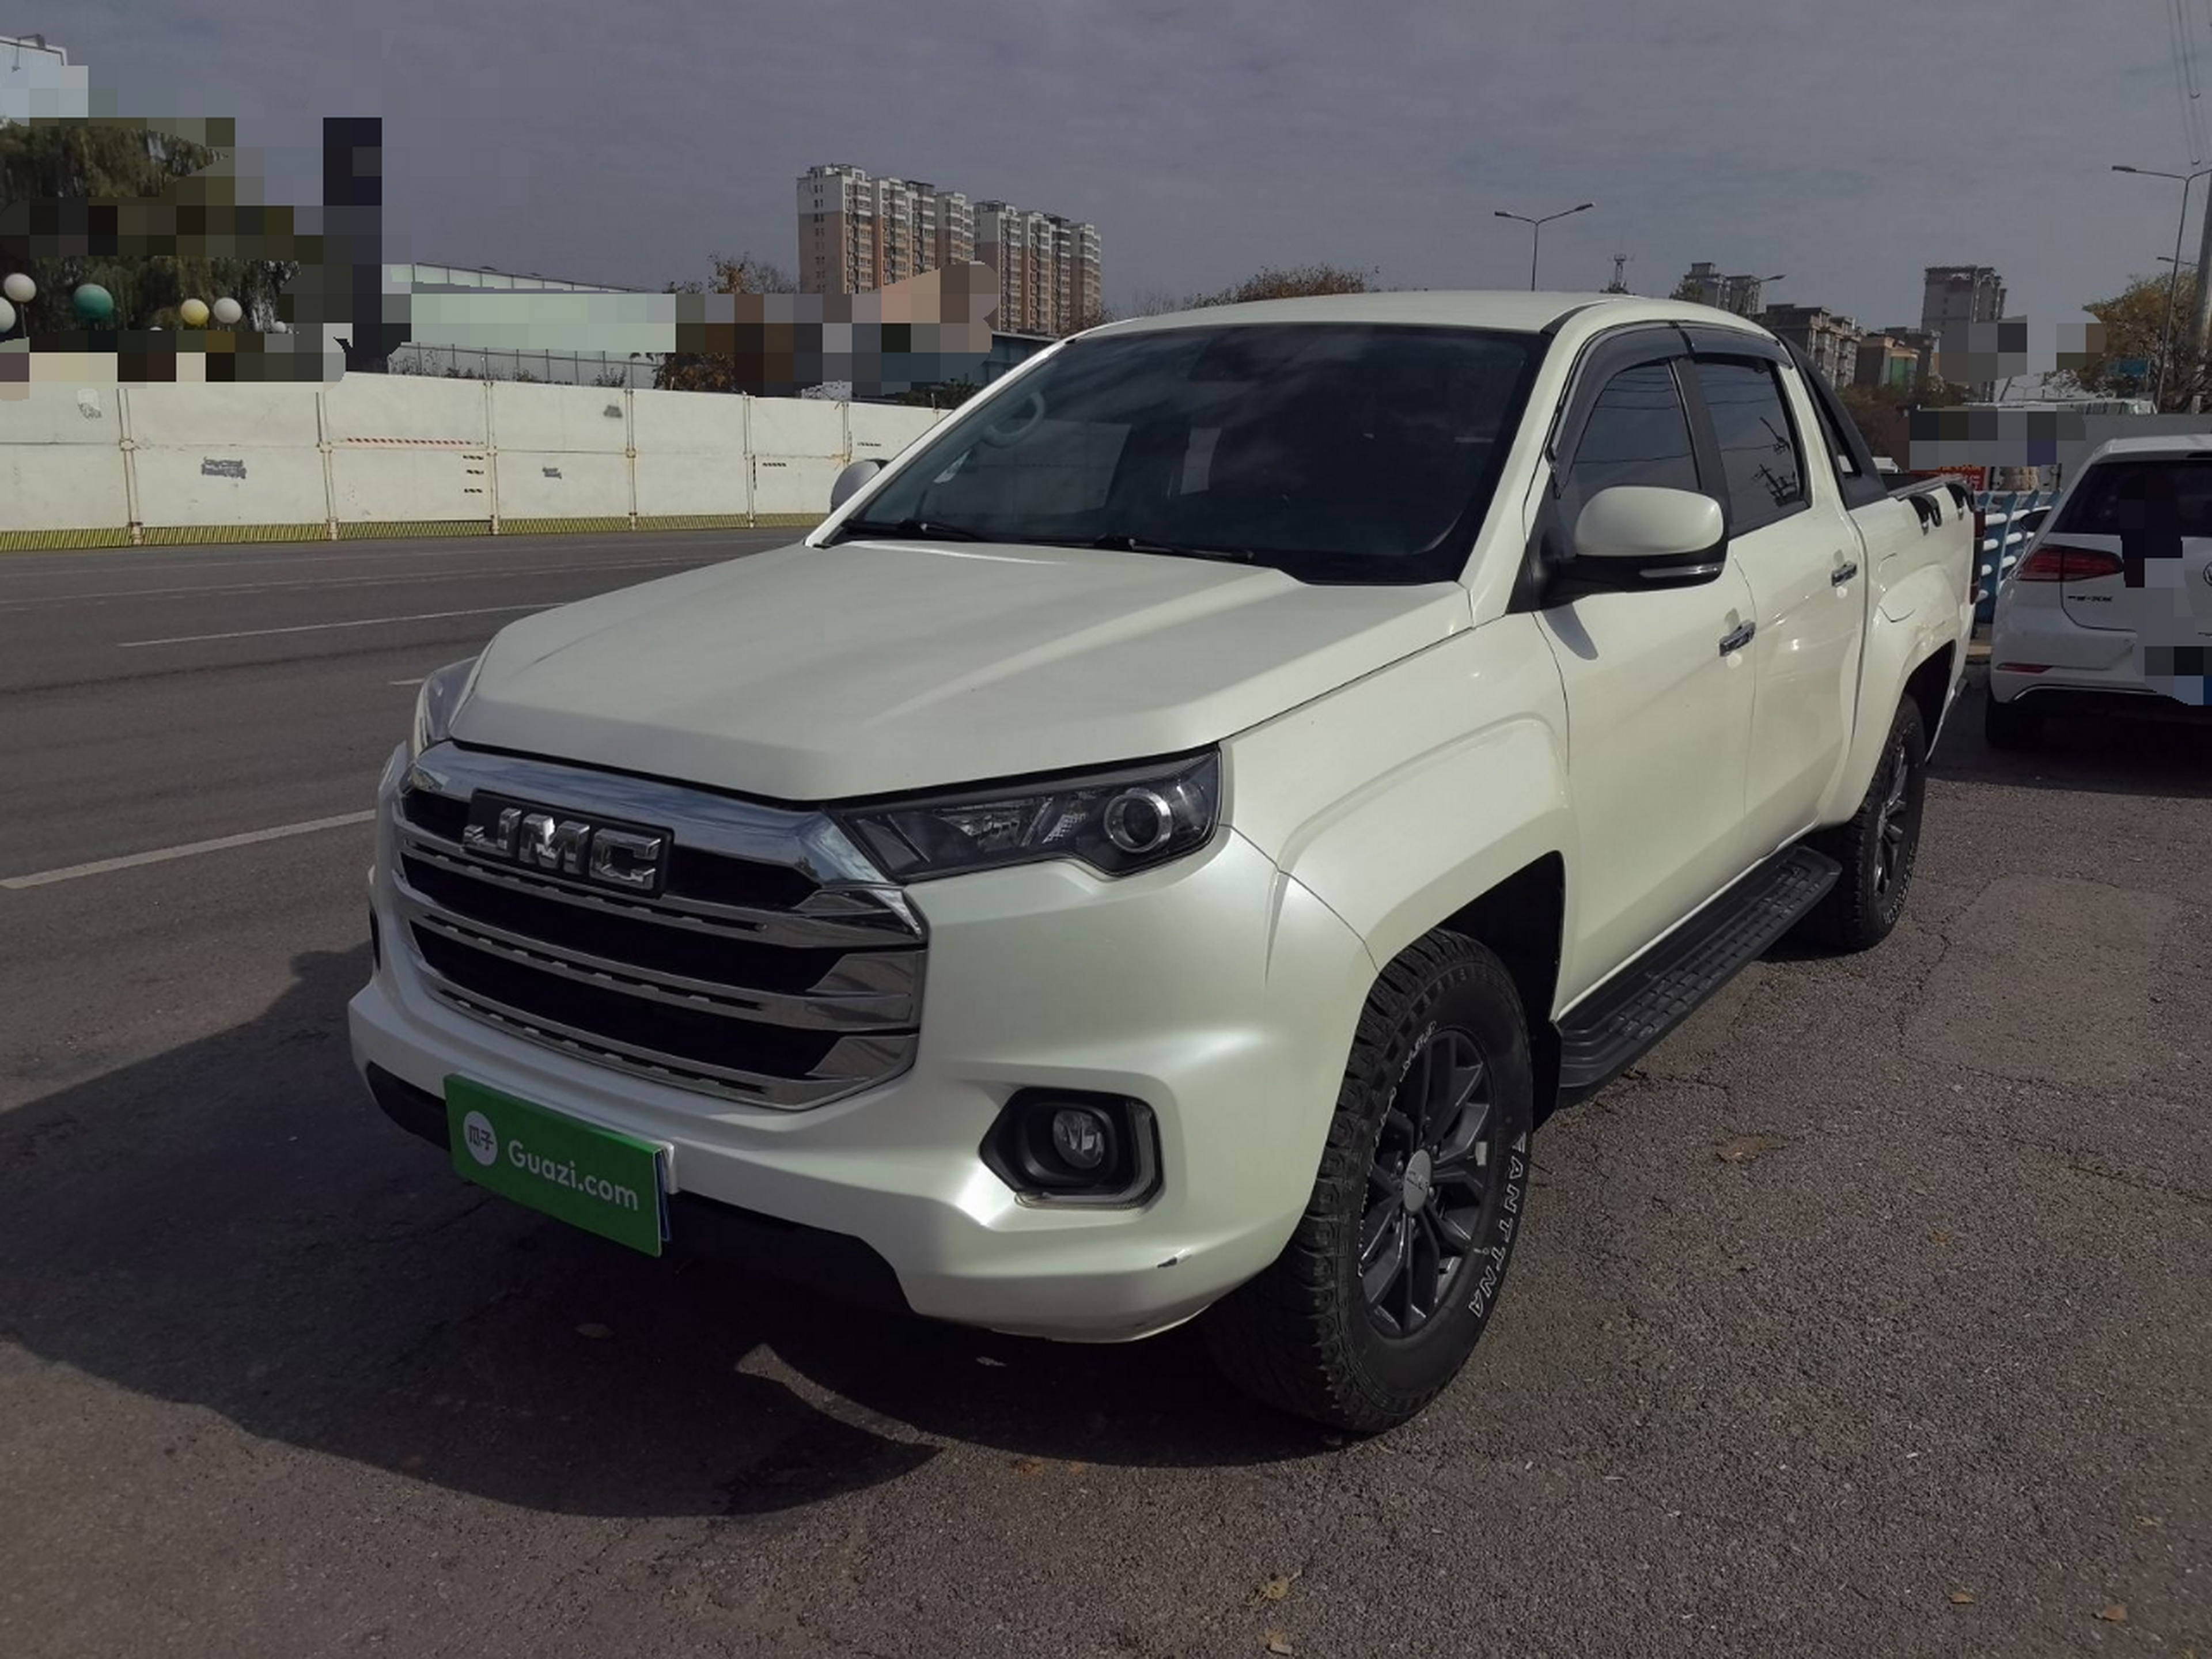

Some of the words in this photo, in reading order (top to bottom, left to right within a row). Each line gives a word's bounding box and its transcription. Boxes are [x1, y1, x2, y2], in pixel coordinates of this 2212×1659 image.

[462, 808, 661, 890] JMC
[468, 1125, 494, 1150] 瓜子
[508, 1140, 638, 1211] Guazi.com
